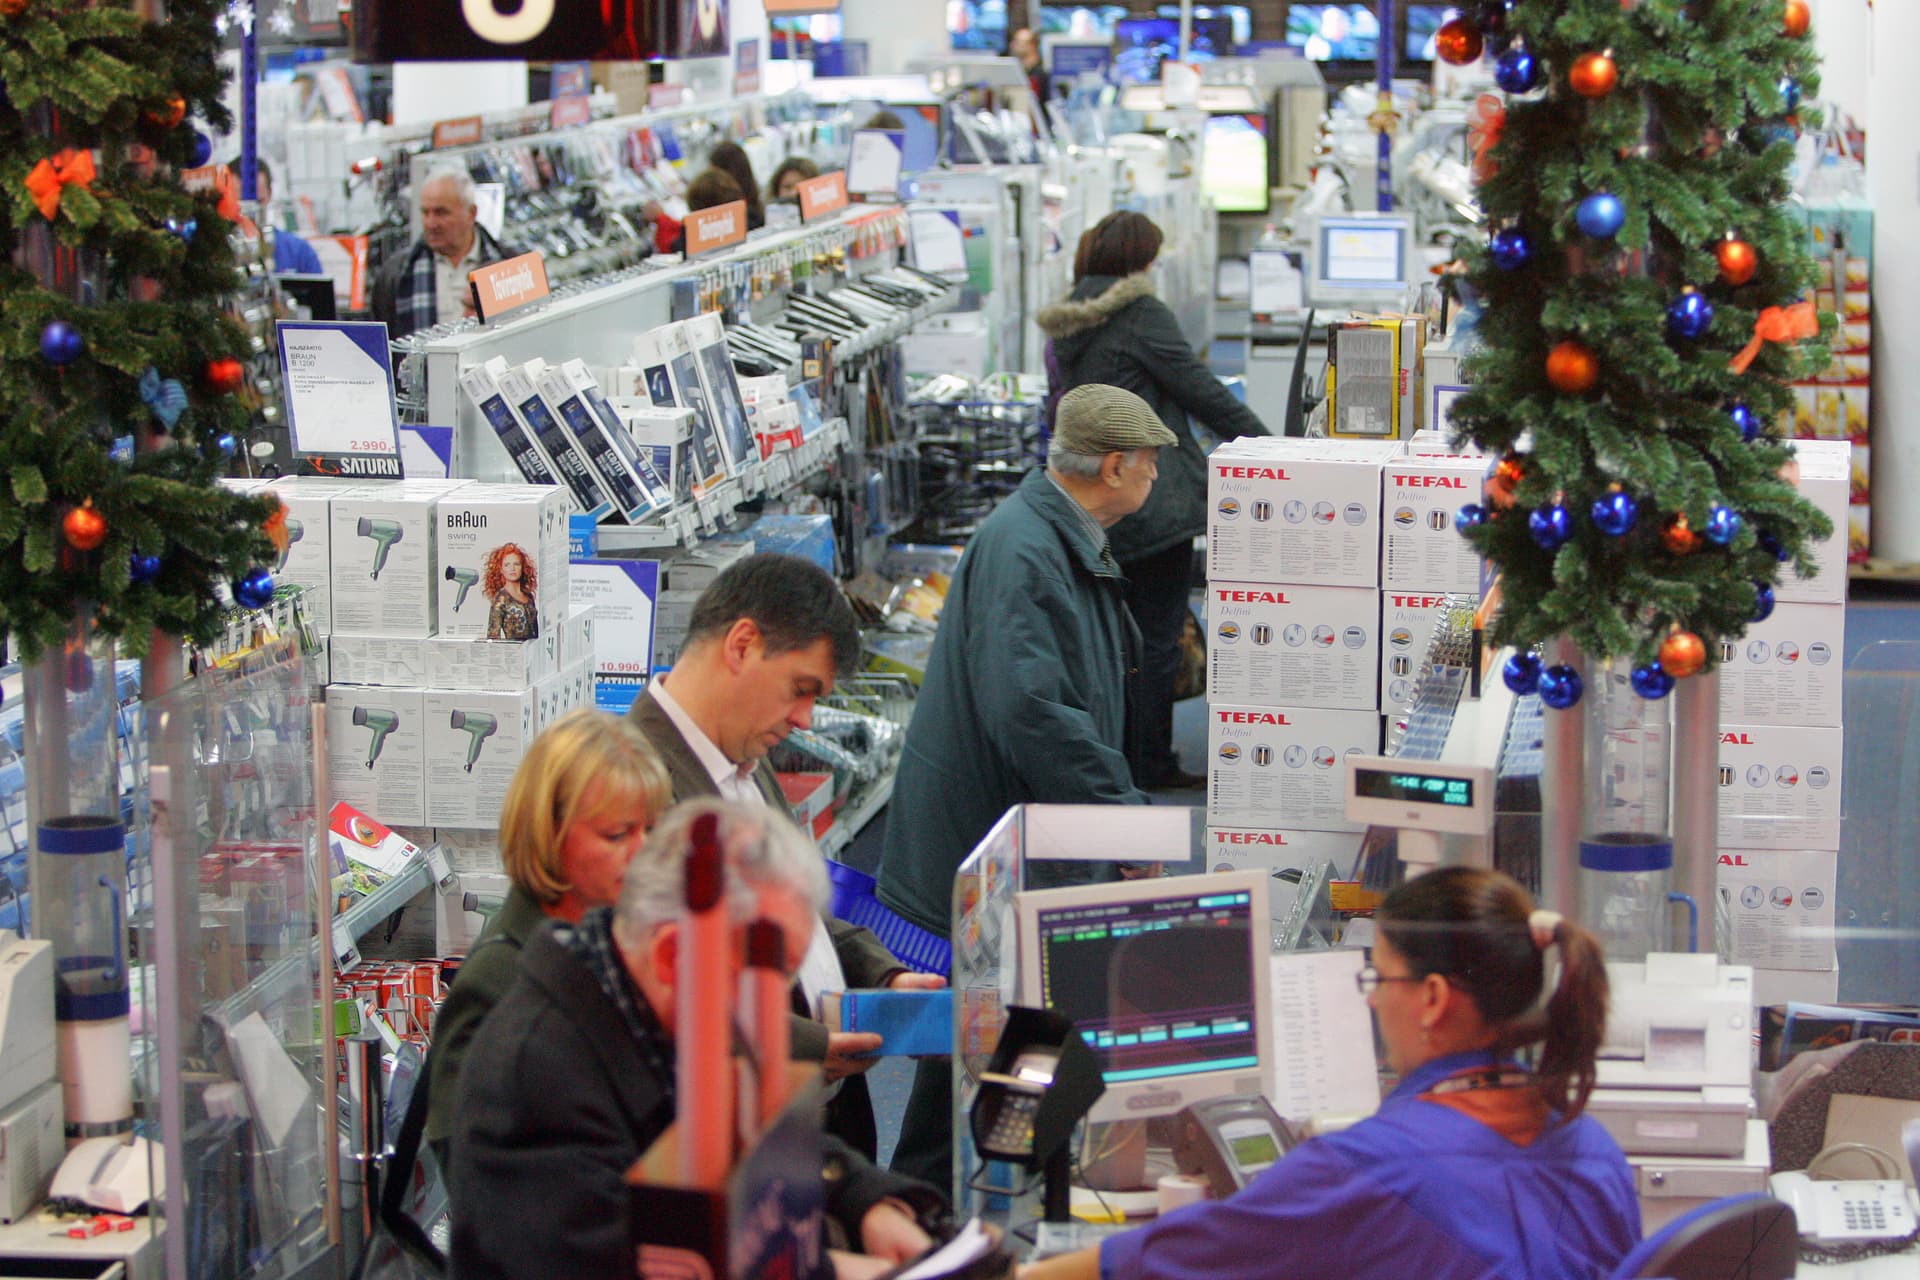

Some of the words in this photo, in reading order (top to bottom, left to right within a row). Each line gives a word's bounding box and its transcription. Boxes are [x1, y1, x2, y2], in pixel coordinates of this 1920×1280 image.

[340, 457, 399, 475] SATURN
[1216, 466, 1291, 480] TEFAL
[1392, 475, 1468, 488] TEFAL
[447, 533, 477, 542] swing
[1216, 590, 1291, 604] TEFAL
[1391, 596, 1446, 608] TEFA
[1217, 712, 1292, 725] TEFAL
[1214, 832, 1288, 845] TEFAL
